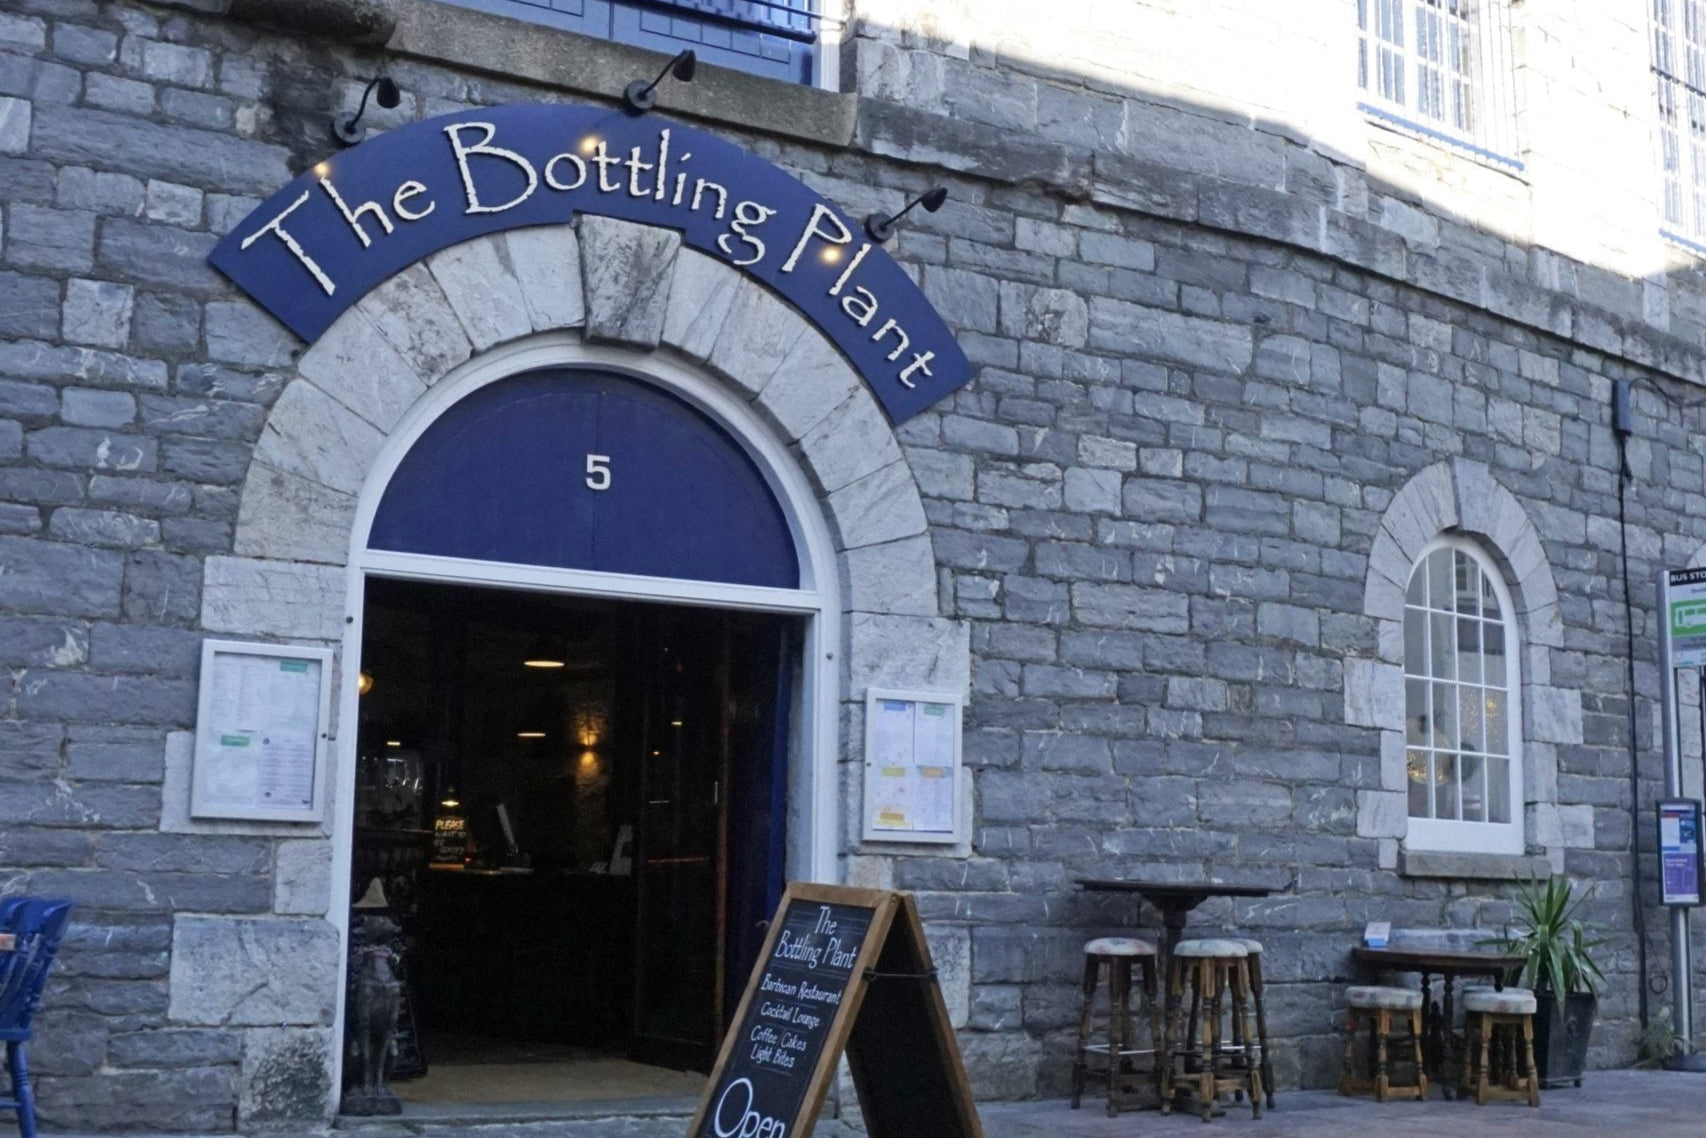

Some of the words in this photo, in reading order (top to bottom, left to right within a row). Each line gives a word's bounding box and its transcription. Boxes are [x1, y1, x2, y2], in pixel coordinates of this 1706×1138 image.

[241, 175, 435, 296] The
[443, 121, 776, 265] Bottling
[781, 203, 935, 388] Plant
[586, 453, 611, 490] 5
[1670, 572, 1688, 582] BUS
[435, 819, 465, 830] PLEASE
[815, 905, 837, 935] The
[774, 930, 822, 969] Bottling
[822, 937, 857, 969] Plant
[761, 973, 797, 995] Barbican
[797, 981, 842, 1004] Restaurant
[761, 1002, 793, 1020] Cocktail
[792, 1007, 820, 1029] Lounge
[750, 1025, 778, 1044] Coffee
[781, 1032, 807, 1051] Cakes
[750, 1043, 773, 1064] Light
[773, 1048, 795, 1068] Bites
[714, 1077, 786, 1138] Open
